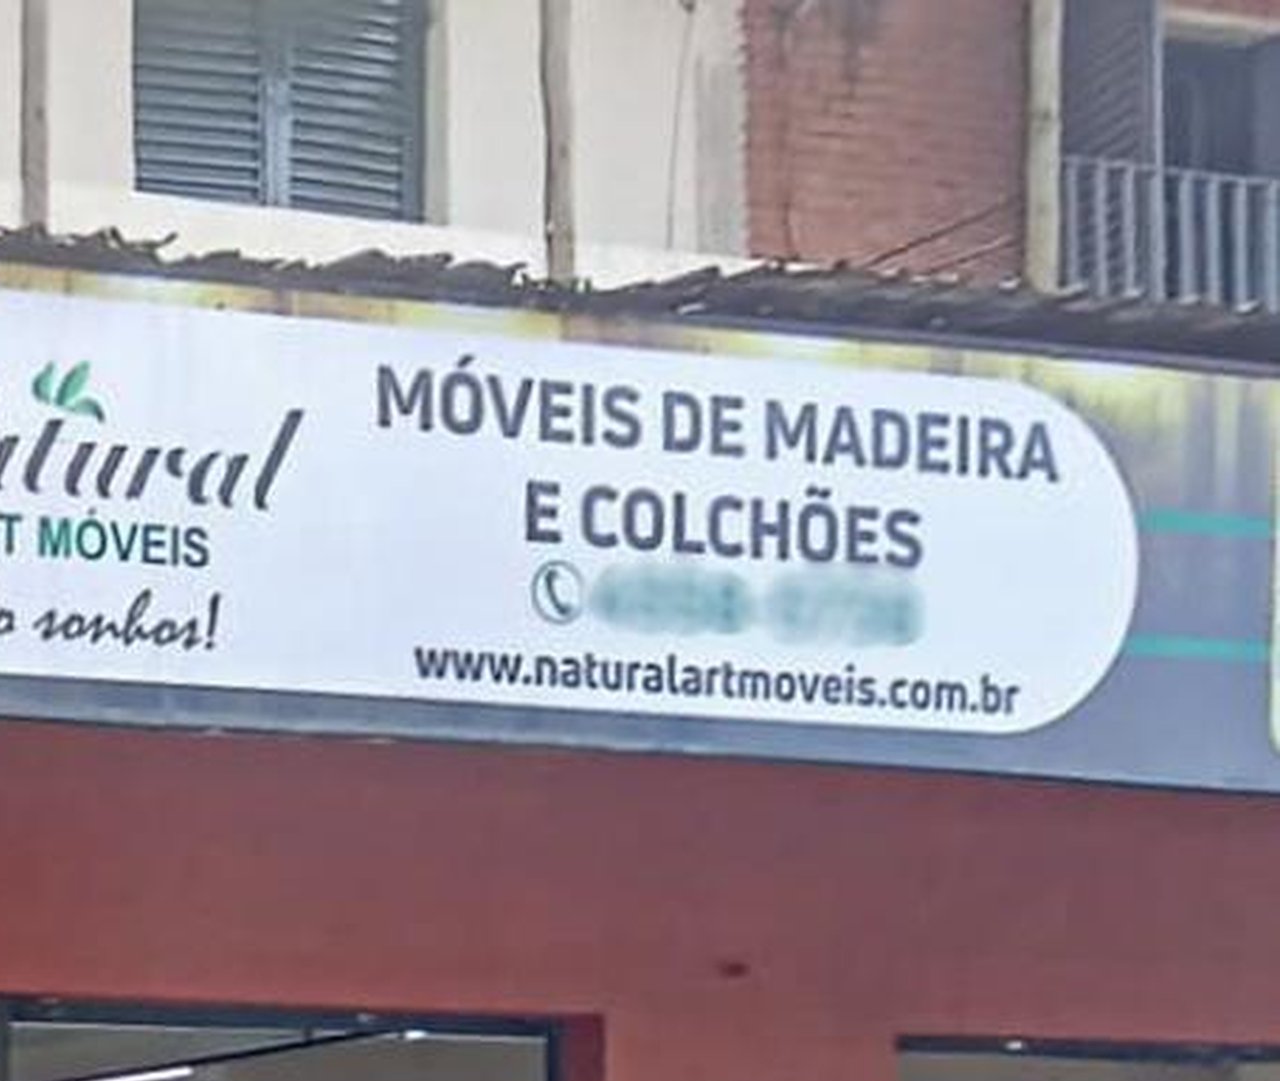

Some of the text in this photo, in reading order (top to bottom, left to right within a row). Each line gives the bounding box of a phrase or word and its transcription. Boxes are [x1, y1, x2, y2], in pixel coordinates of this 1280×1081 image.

[375, 356, 1059, 484] MÓVEIS DE MADEIRA
[39, 507, 211, 569] MÓVEIS
[523, 480, 925, 569] E COLCHÕES
[32, 591, 223, 651] sonhos!
[414, 645, 1020, 716] www.naturalartmoveis.com.br
